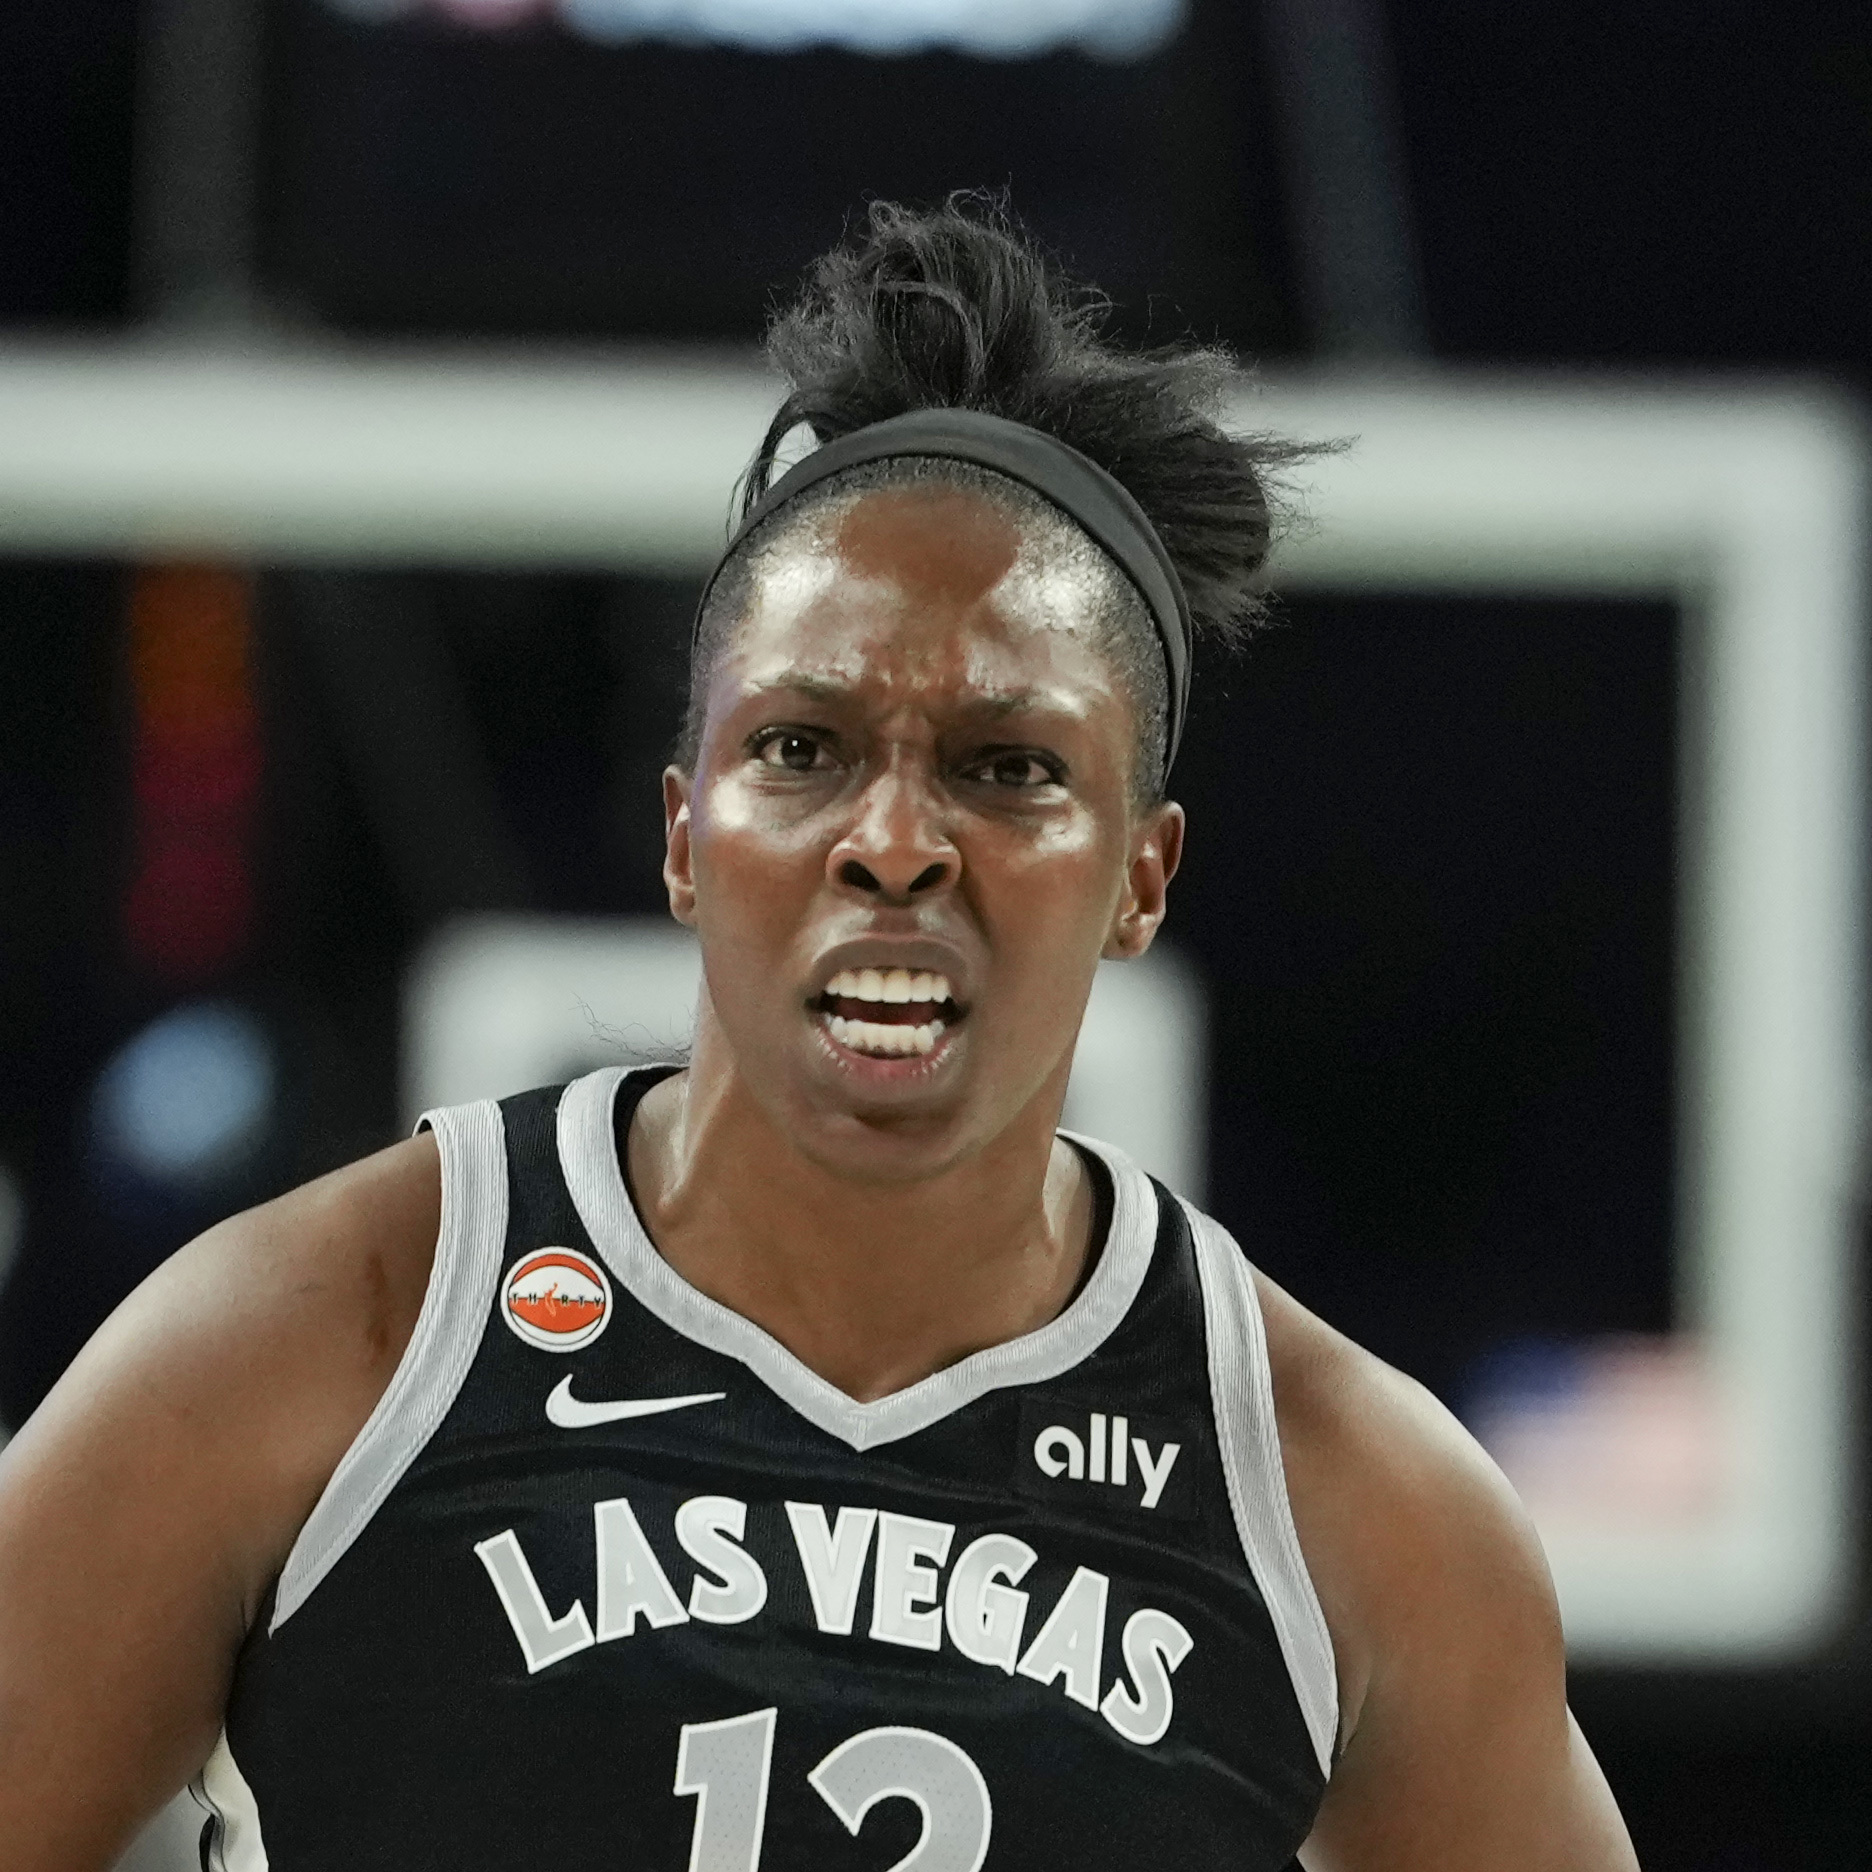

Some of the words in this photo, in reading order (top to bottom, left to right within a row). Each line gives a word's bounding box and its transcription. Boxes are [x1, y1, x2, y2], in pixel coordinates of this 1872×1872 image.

[1032, 1413, 1182, 1509] ally
[472, 1494, 768, 1676] LAS
[782, 1499, 1196, 1747] VEGAS
